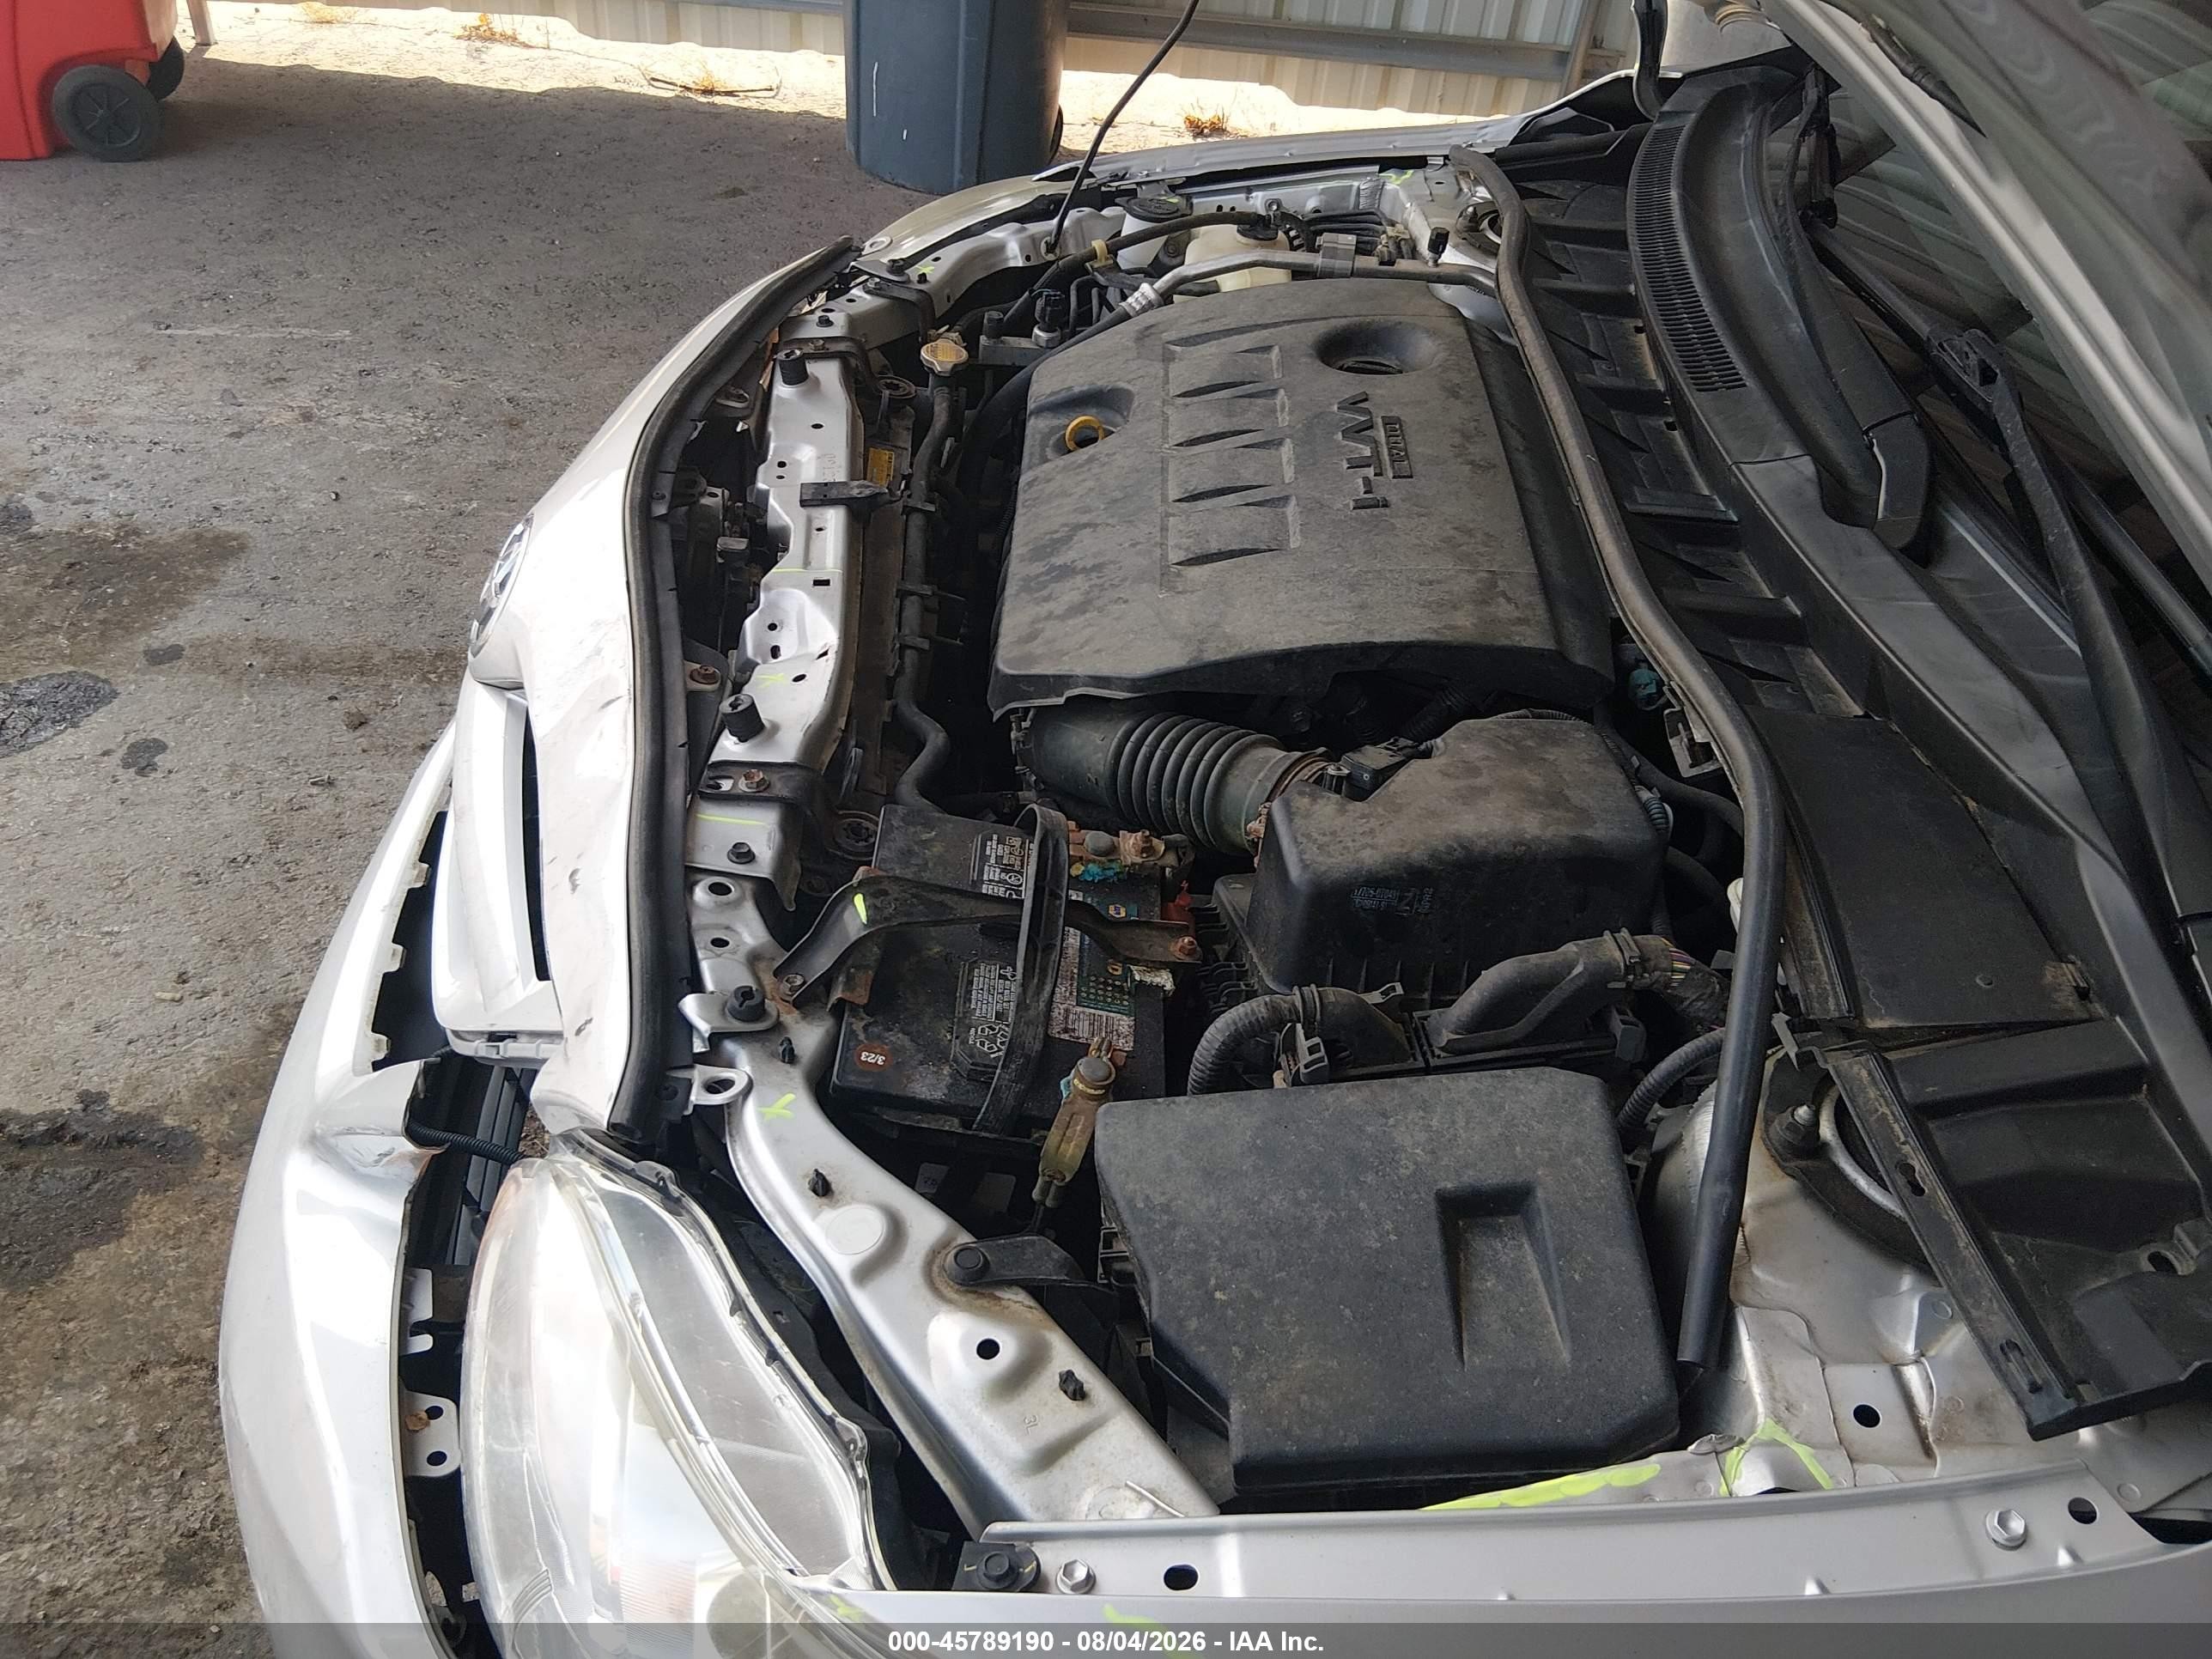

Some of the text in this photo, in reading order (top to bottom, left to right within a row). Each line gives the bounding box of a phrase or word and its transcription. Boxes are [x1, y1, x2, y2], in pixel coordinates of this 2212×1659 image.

[1335, 391, 1389, 510] VVT-i
[1383, 422, 1411, 476] DUAL
[860, 1051, 886, 1066] 3/23
